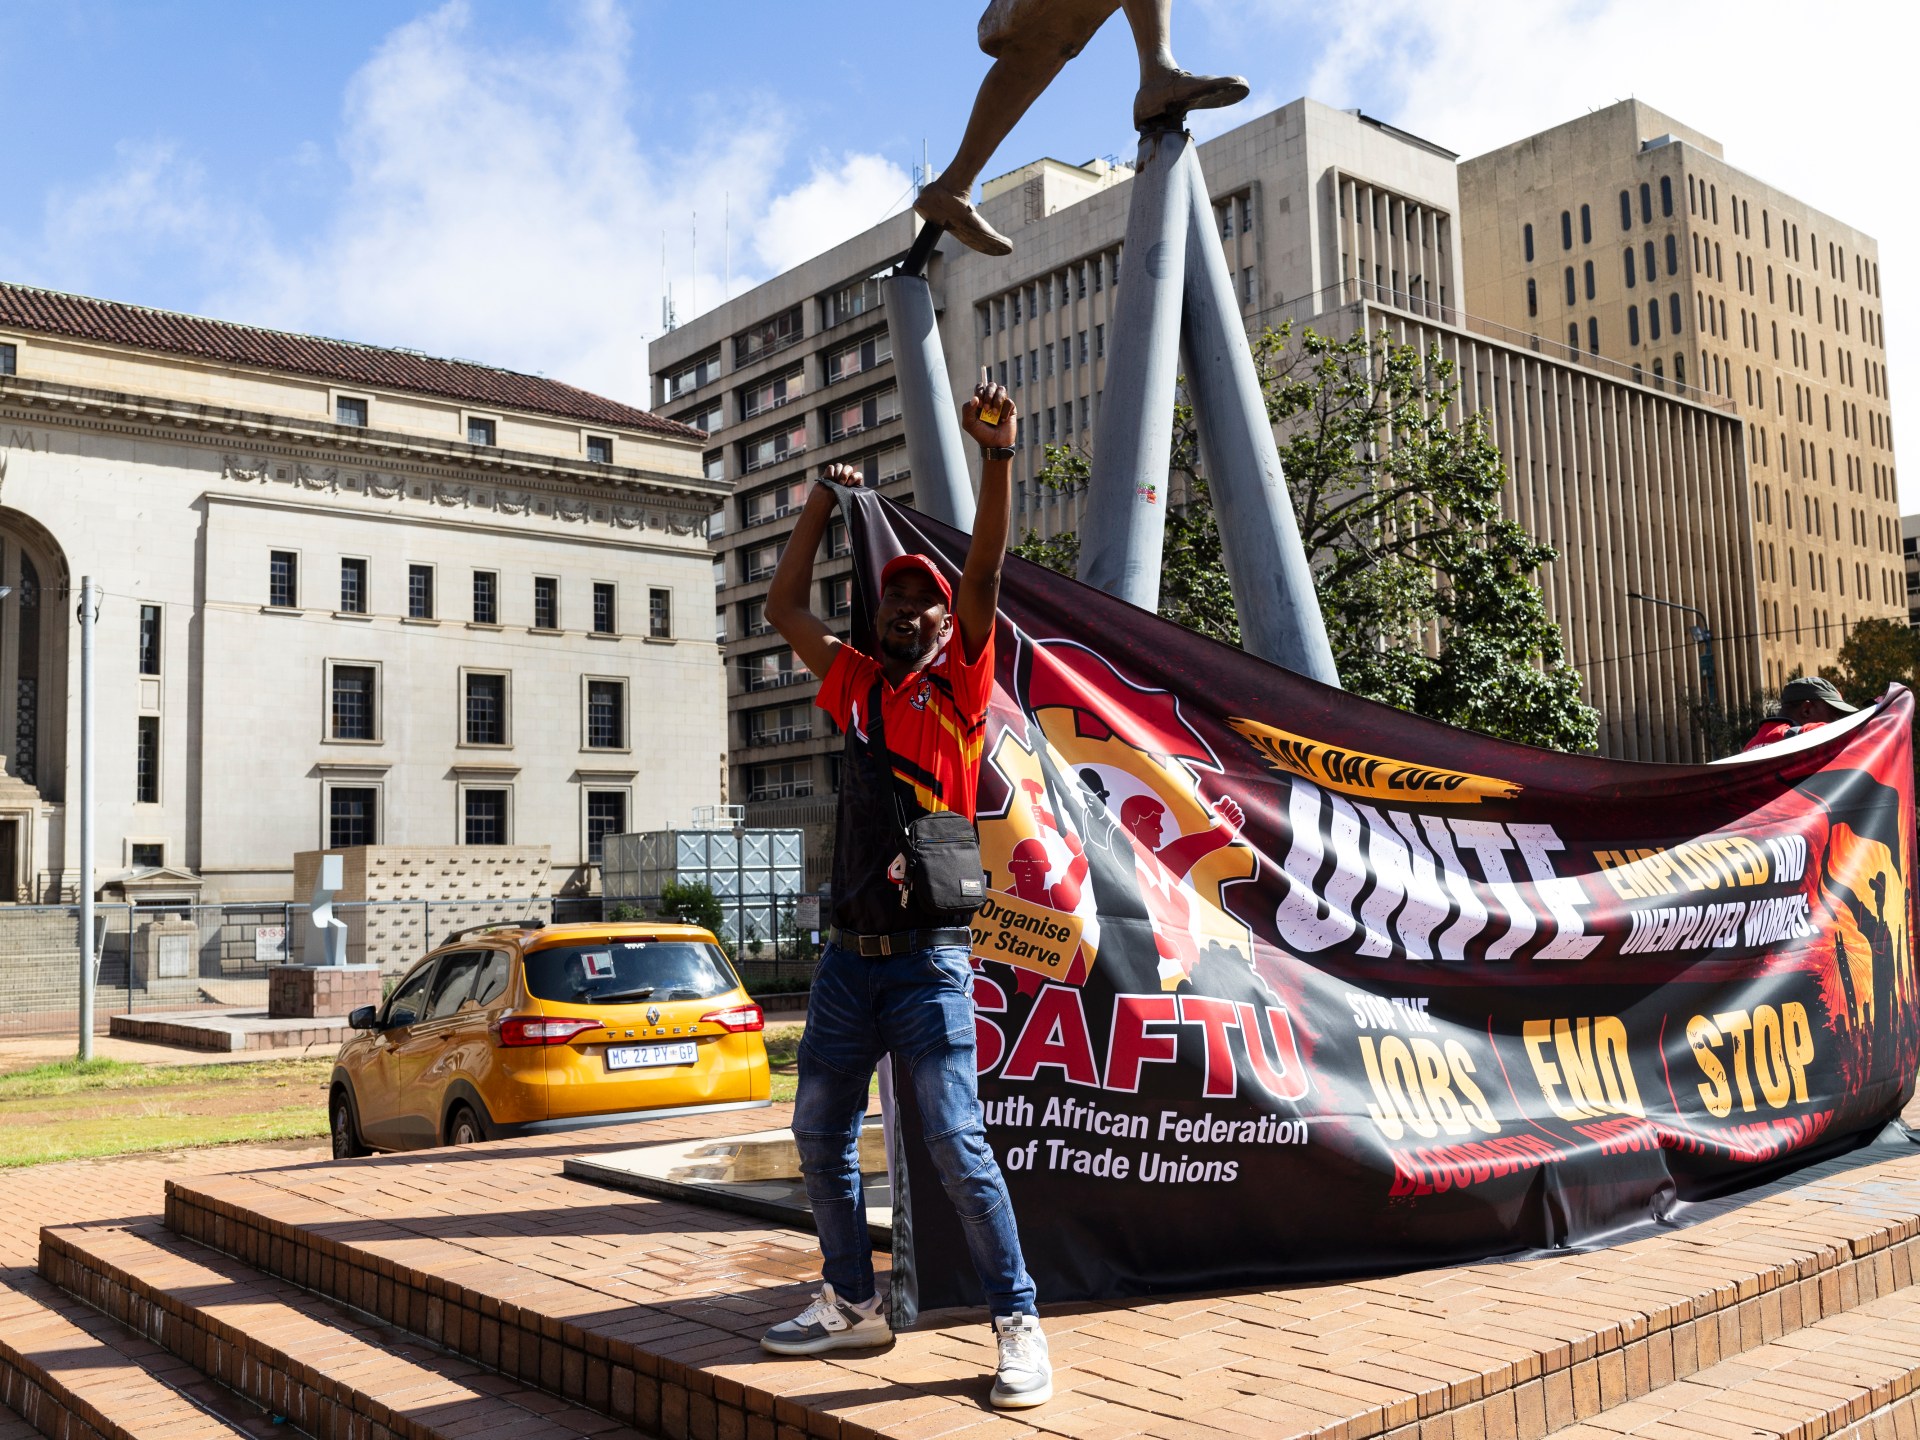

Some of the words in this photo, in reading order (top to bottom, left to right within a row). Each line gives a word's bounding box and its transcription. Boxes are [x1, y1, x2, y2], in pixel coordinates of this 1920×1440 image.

[1249, 733, 1318, 777] MAY
[1321, 749, 1388, 788] DAY
[1276, 774, 1606, 960] UNITE
[1593, 836, 1769, 900] EMPLOYED
[1766, 834, 1807, 883] AND
[979, 898, 1071, 943] Organise
[1619, 902, 1746, 955] UNEMPLOYED
[971, 928, 993, 946] or
[994, 930, 1061, 967] Starve
[607, 1025, 698, 1040] TRIBER
[1344, 991, 1398, 1030] STOP
[1390, 997, 1438, 1033] THE
[612, 1049, 628, 1065] MC
[633, 1048, 648, 1063] 22
[654, 1046, 668, 1062] PY
[679, 1044, 694, 1060] GP
[1523, 1015, 1646, 1122] END
[1687, 1002, 1815, 1118] STOP
[1357, 1034, 1502, 1141] JOBS
[982, 1095, 1034, 1127] uth
[1040, 1096, 1148, 1139] African
[1157, 1110, 1309, 1145] Federation
[1006, 1139, 1038, 1171] of
[1045, 1139, 1130, 1179] Trade
[1138, 1151, 1239, 1183] Unions
[1388, 1133, 1567, 1197] BLOODBATH!
